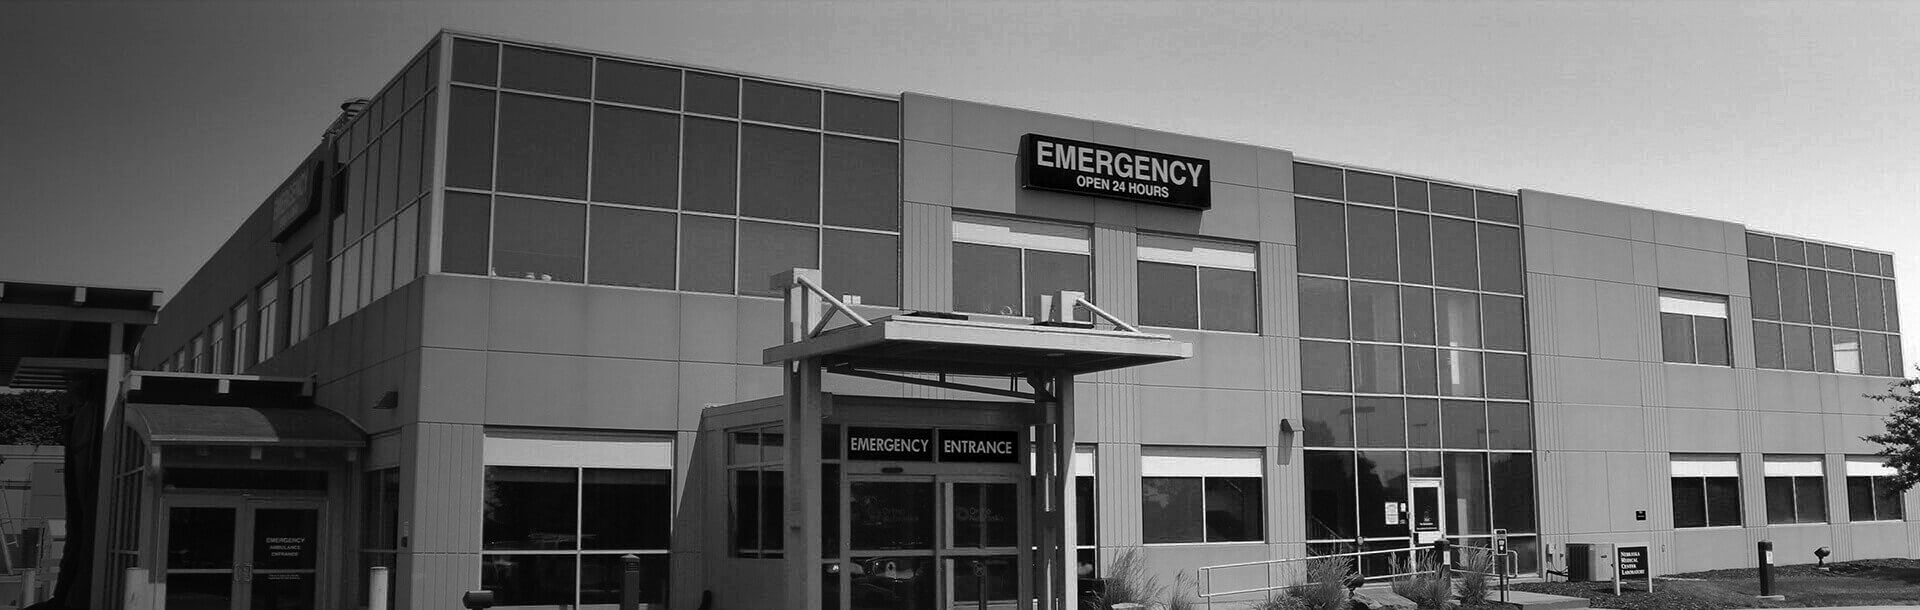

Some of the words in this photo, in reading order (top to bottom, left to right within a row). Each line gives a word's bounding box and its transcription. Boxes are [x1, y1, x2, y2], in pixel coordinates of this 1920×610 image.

[1037, 140, 1203, 187] EMERGENCY
[1076, 175, 1110, 191] OPEN
[1112, 181, 1126, 193] 24
[1128, 182, 1169, 199] HOURS
[850, 437, 929, 453] EMERGENCY
[944, 440, 1012, 454] ENTRANCE
